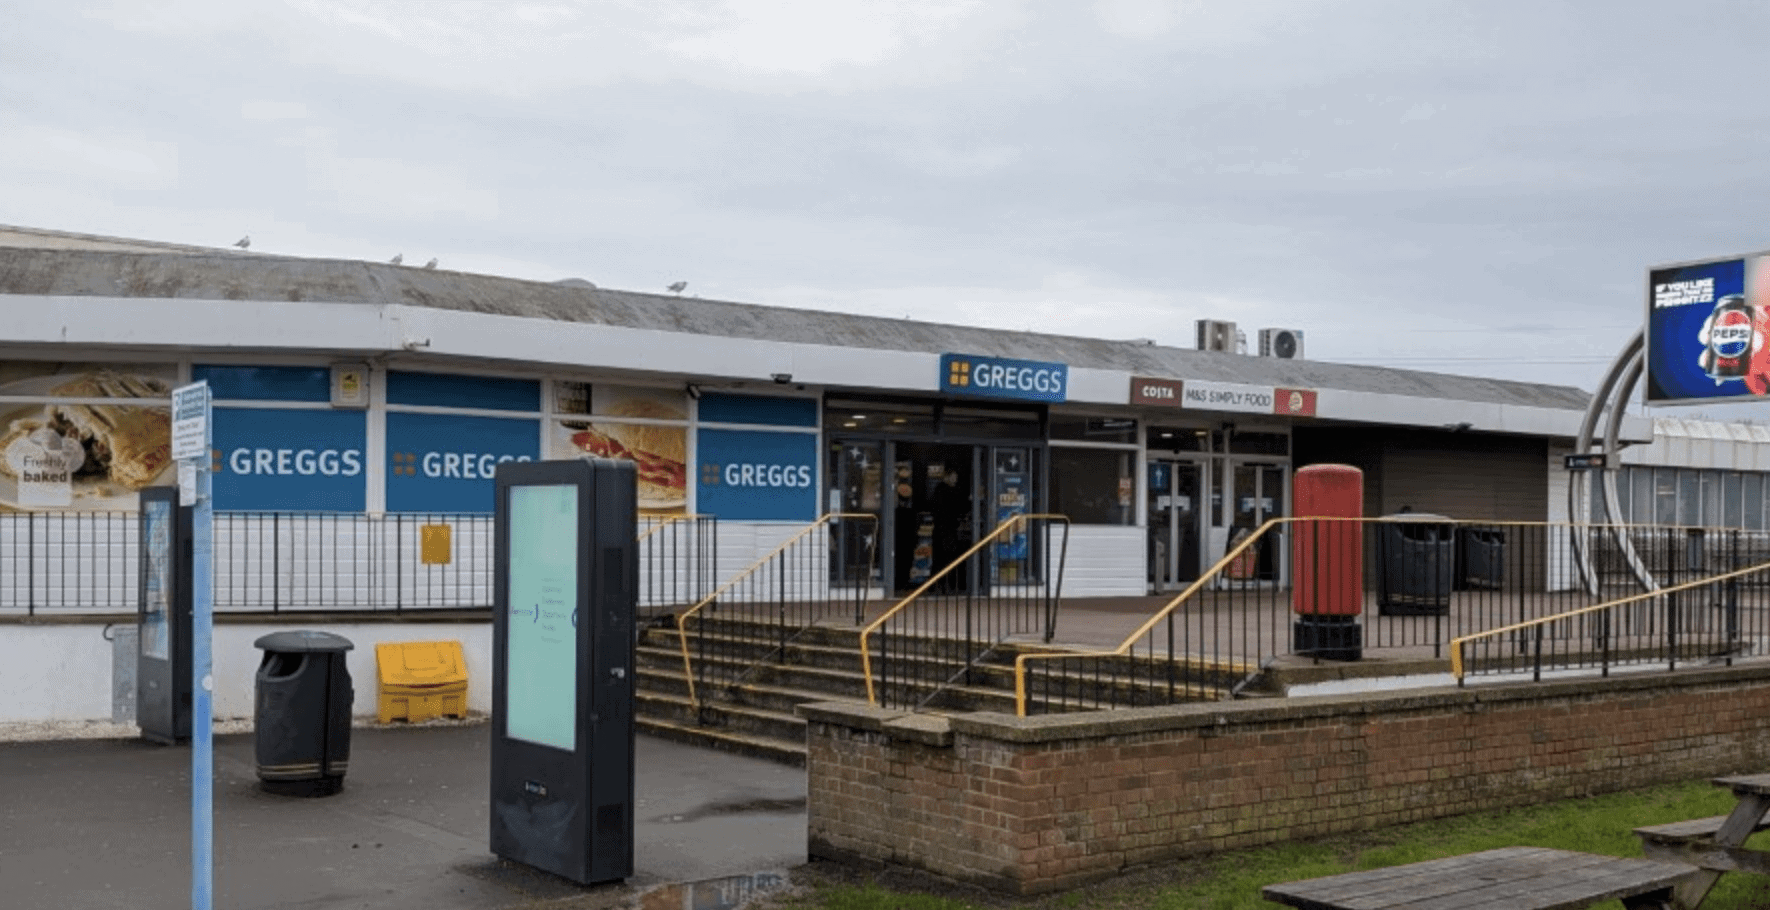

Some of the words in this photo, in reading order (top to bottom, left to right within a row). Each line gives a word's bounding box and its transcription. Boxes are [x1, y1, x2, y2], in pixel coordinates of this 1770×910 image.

[973, 363, 1061, 393] GREGGS
[1142, 385, 1174, 399] COSTA
[1186, 389, 1207, 403] M&S
[1209, 391, 1242, 405] SIMPLY
[1244, 393, 1271, 407] FOOD
[23, 455, 67, 470] Freshly
[229, 448, 361, 476] GREGGS
[423, 451, 532, 479] GREG
[23, 469, 68, 483] baked
[725, 463, 811, 487] GREGGS
